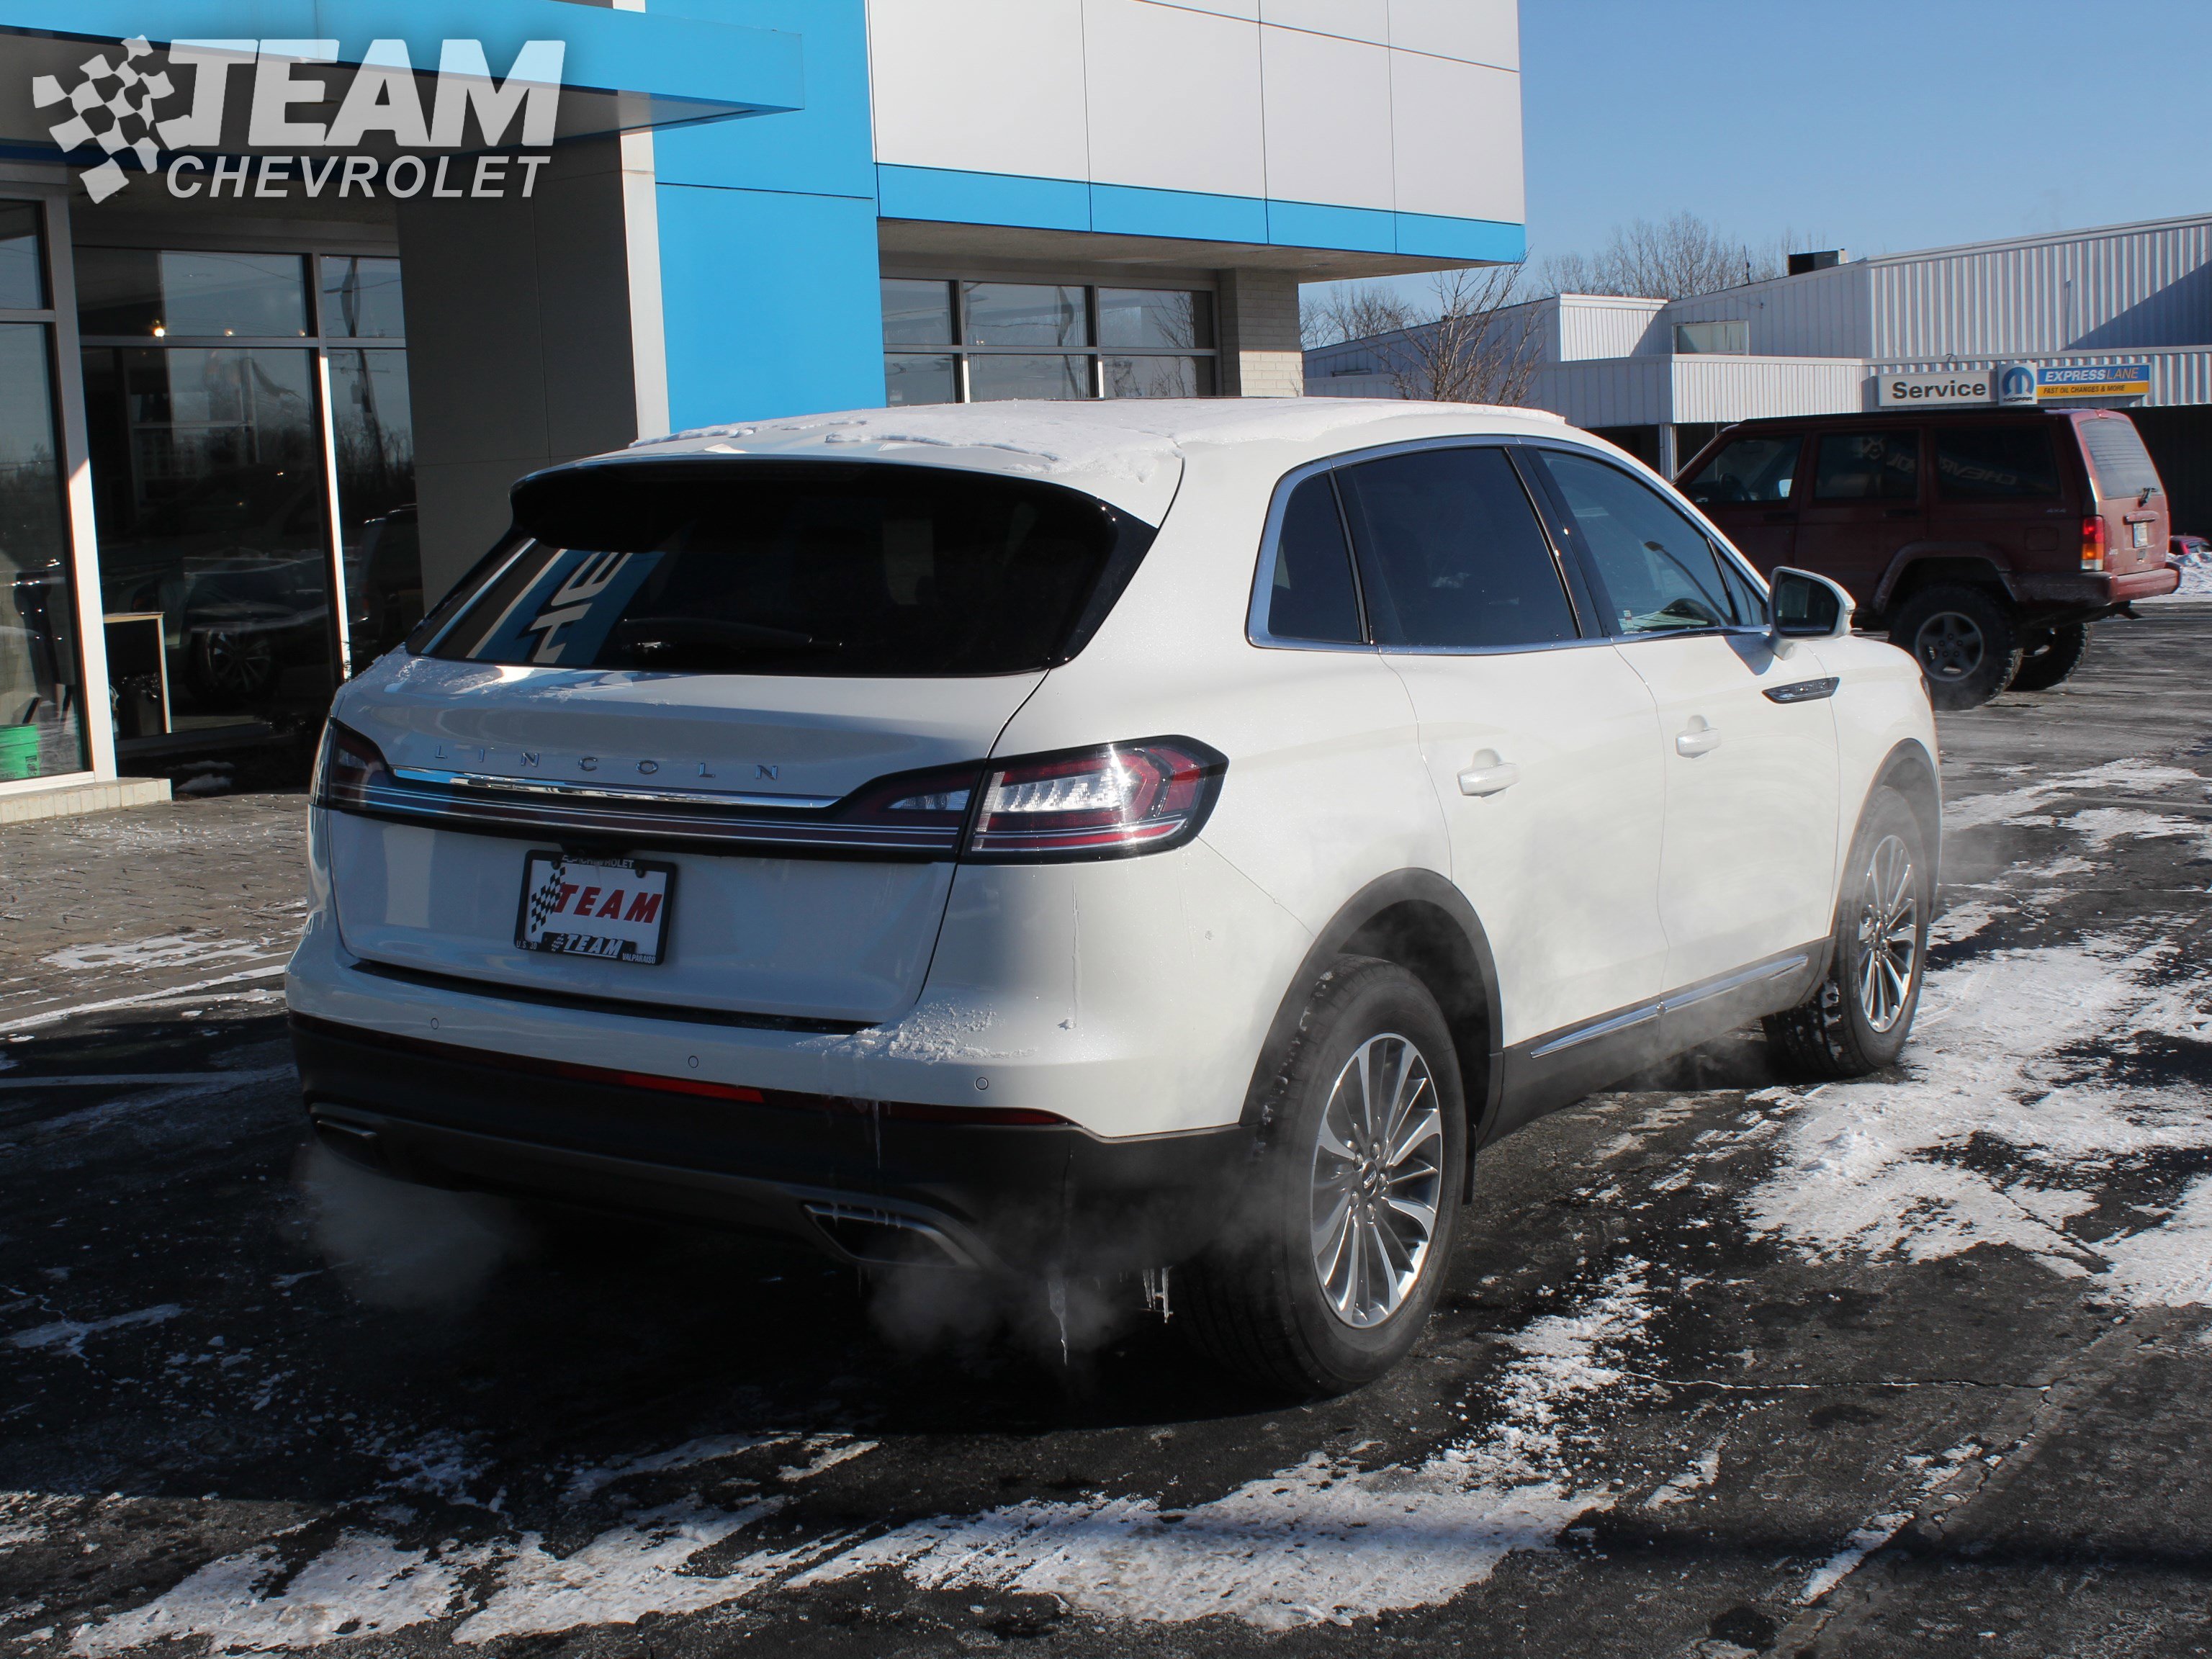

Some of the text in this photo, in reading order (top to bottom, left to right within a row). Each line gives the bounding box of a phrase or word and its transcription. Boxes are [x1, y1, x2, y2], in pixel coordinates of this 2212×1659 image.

[1892, 379, 1987, 400] Service
[434, 745, 778, 781] LINCOLN
[553, 884, 662, 923] TEAM
[563, 933, 624, 956] TEAM
[621, 953, 656, 965] VALPARAISO
